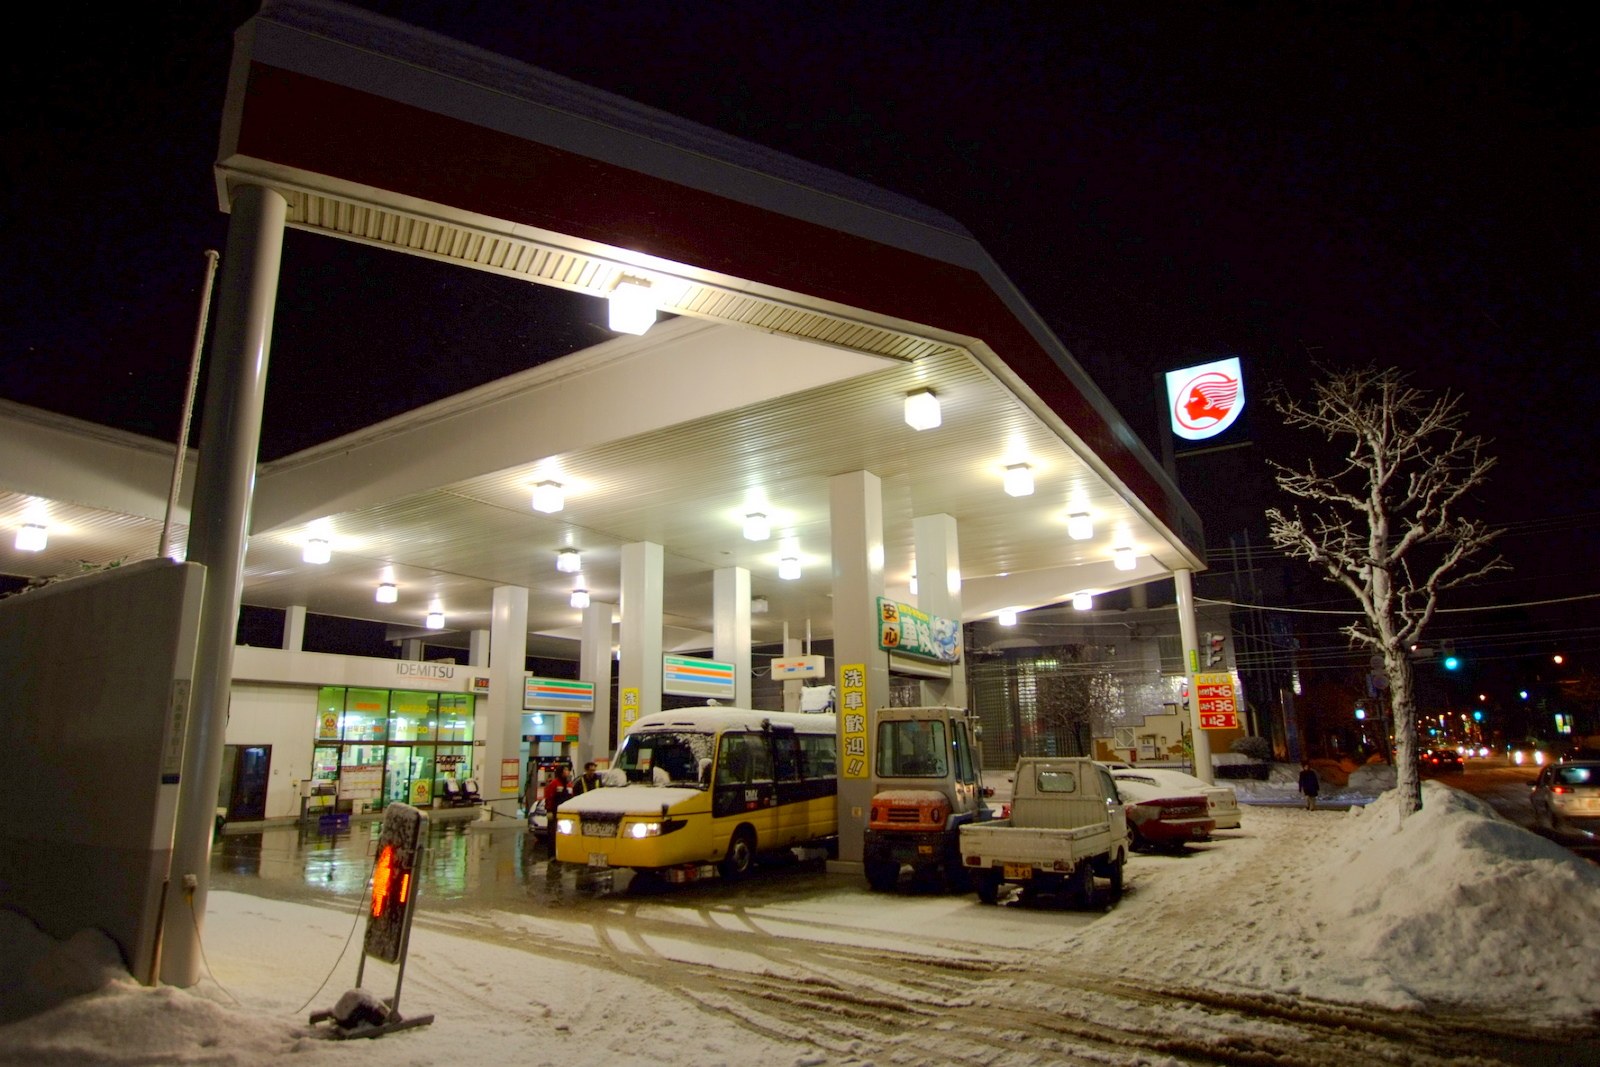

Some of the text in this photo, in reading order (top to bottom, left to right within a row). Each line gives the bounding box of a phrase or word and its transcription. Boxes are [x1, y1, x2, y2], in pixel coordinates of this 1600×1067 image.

[883, 603, 897, 645] 安心
[396, 663, 454, 678] IDEMITSU
[1209, 685, 1232, 697] 146
[1210, 699, 1234, 712] 136
